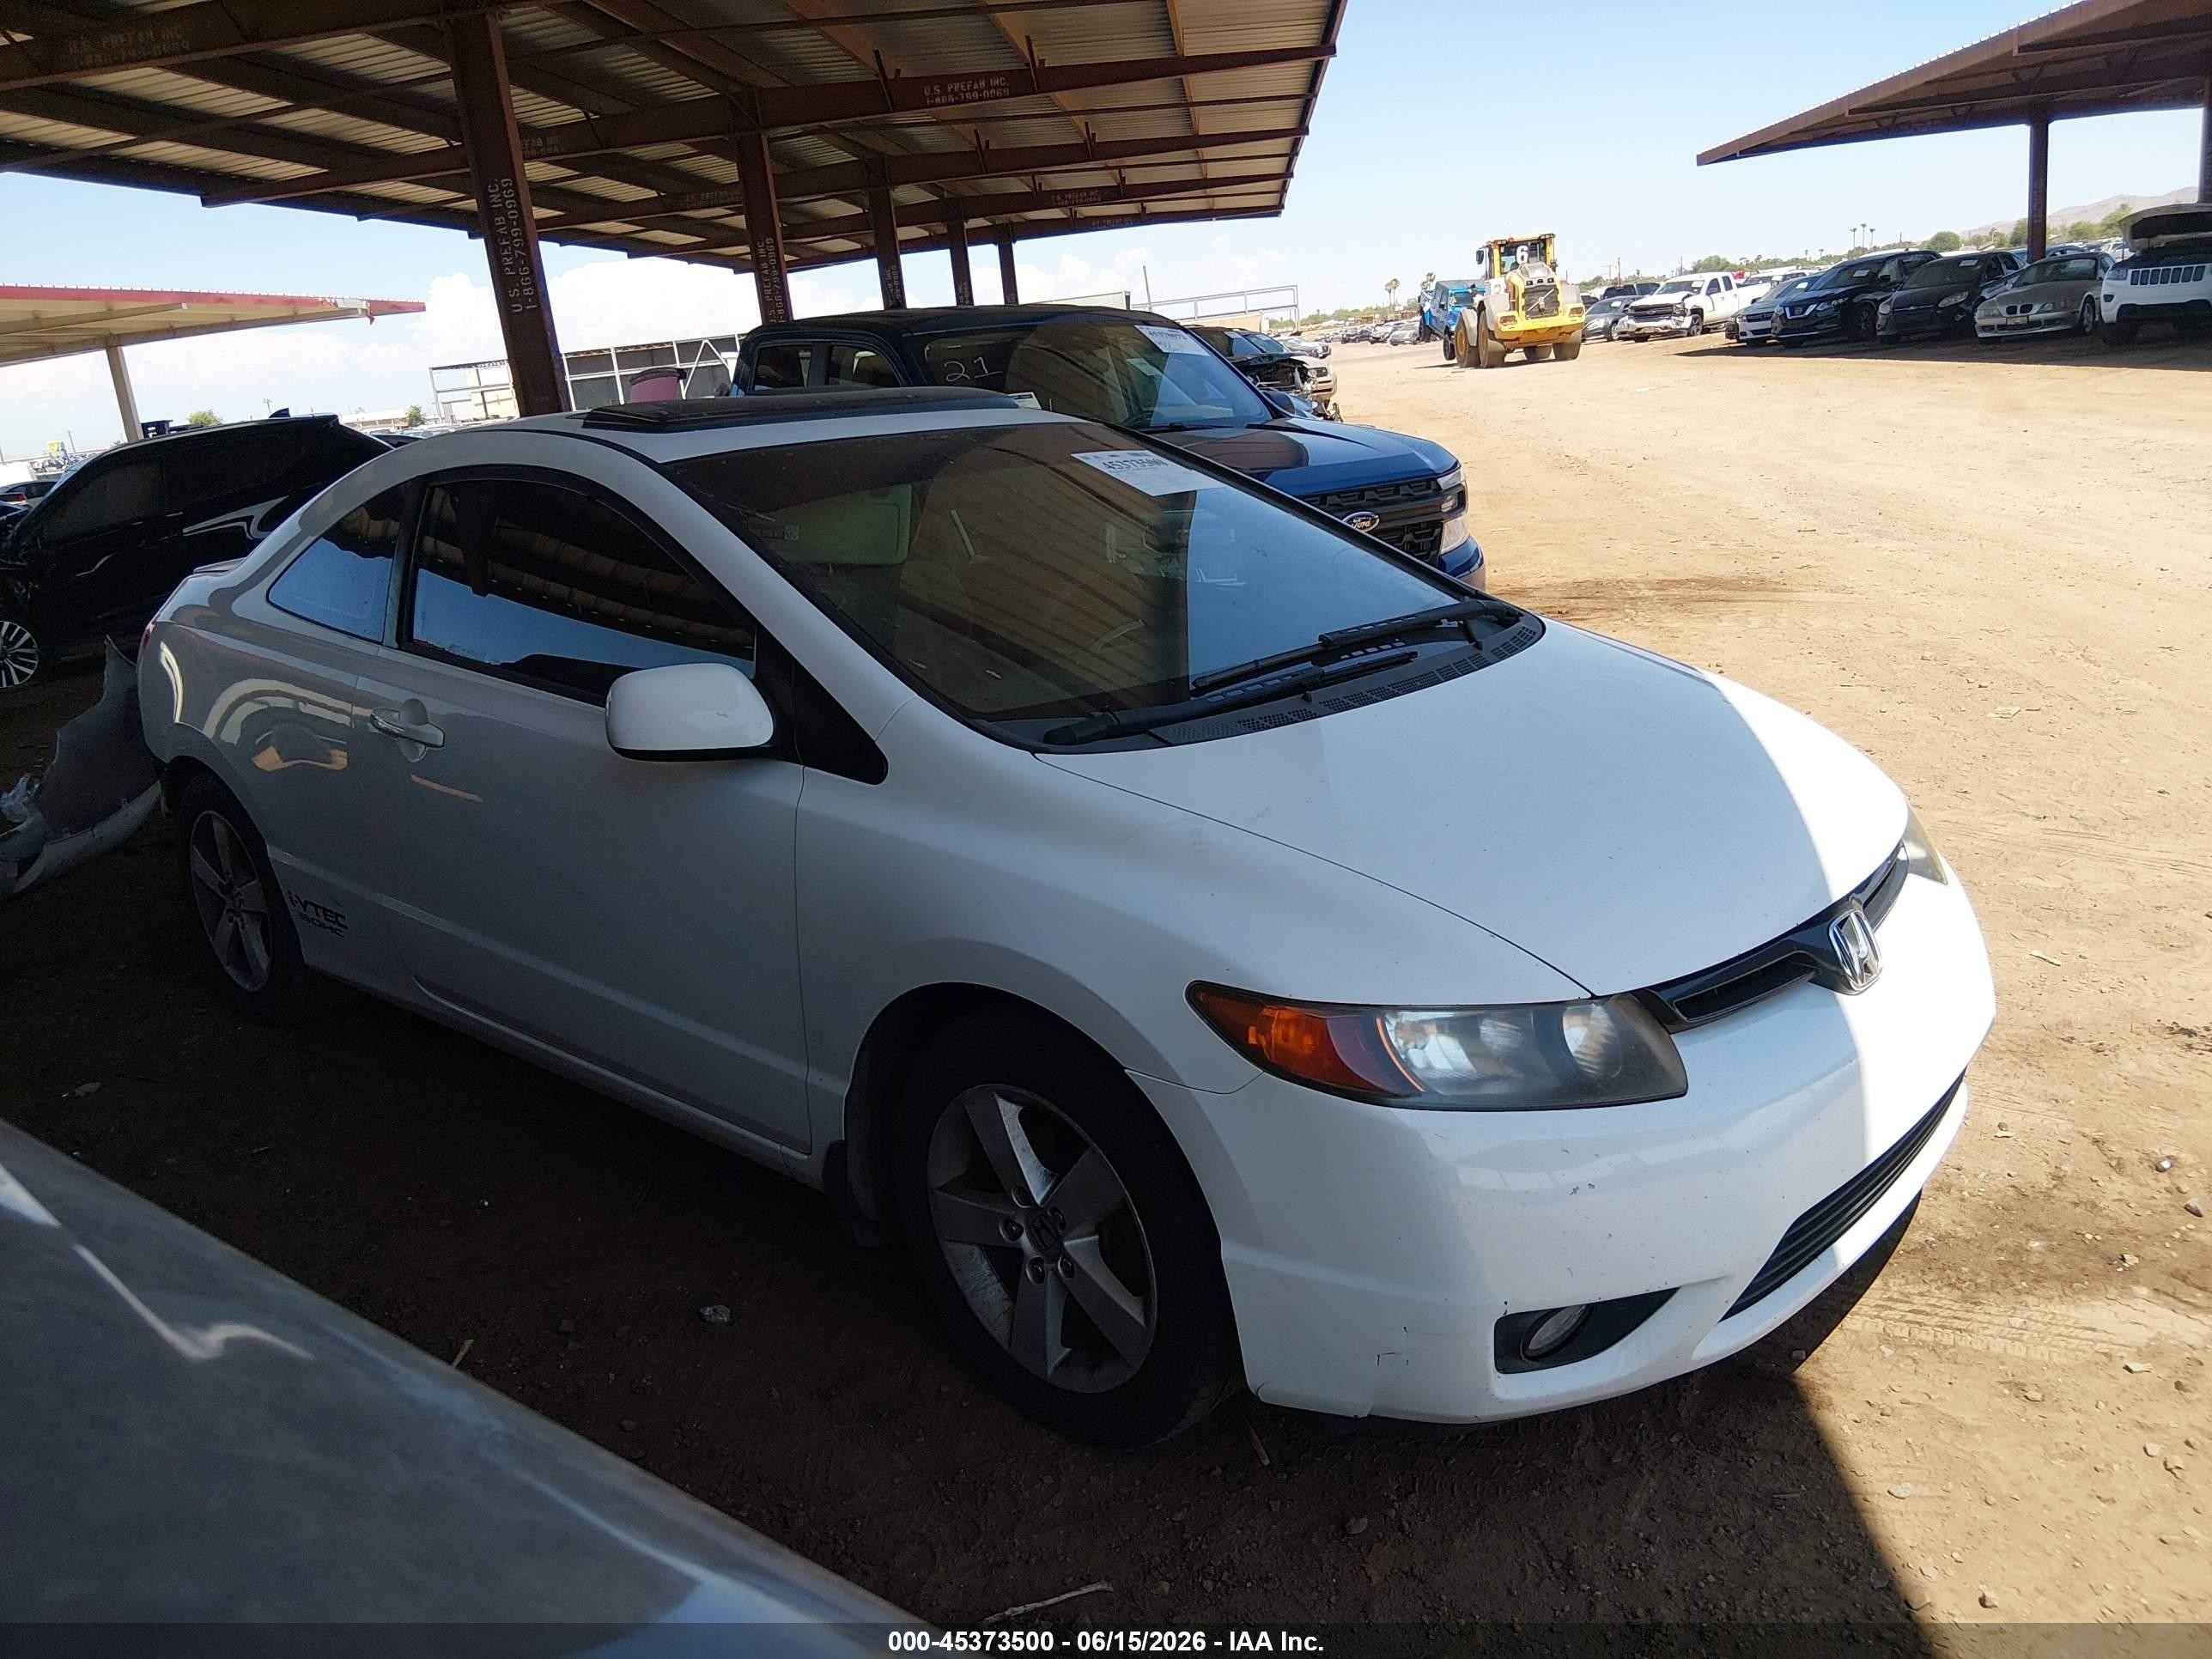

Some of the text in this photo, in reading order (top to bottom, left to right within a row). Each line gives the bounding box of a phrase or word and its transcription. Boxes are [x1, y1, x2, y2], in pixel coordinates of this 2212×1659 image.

[946, 79, 986, 93] PREFAB
[488, 178, 523, 313] U.S. PREFAB INC.
[501, 178, 538, 310] 1-866-799-0969
[1516, 245, 1528, 264] 6
[760, 262, 775, 301] PREFAB
[944, 356, 1003, 382] 21
[1352, 517, 1372, 529] Ford
